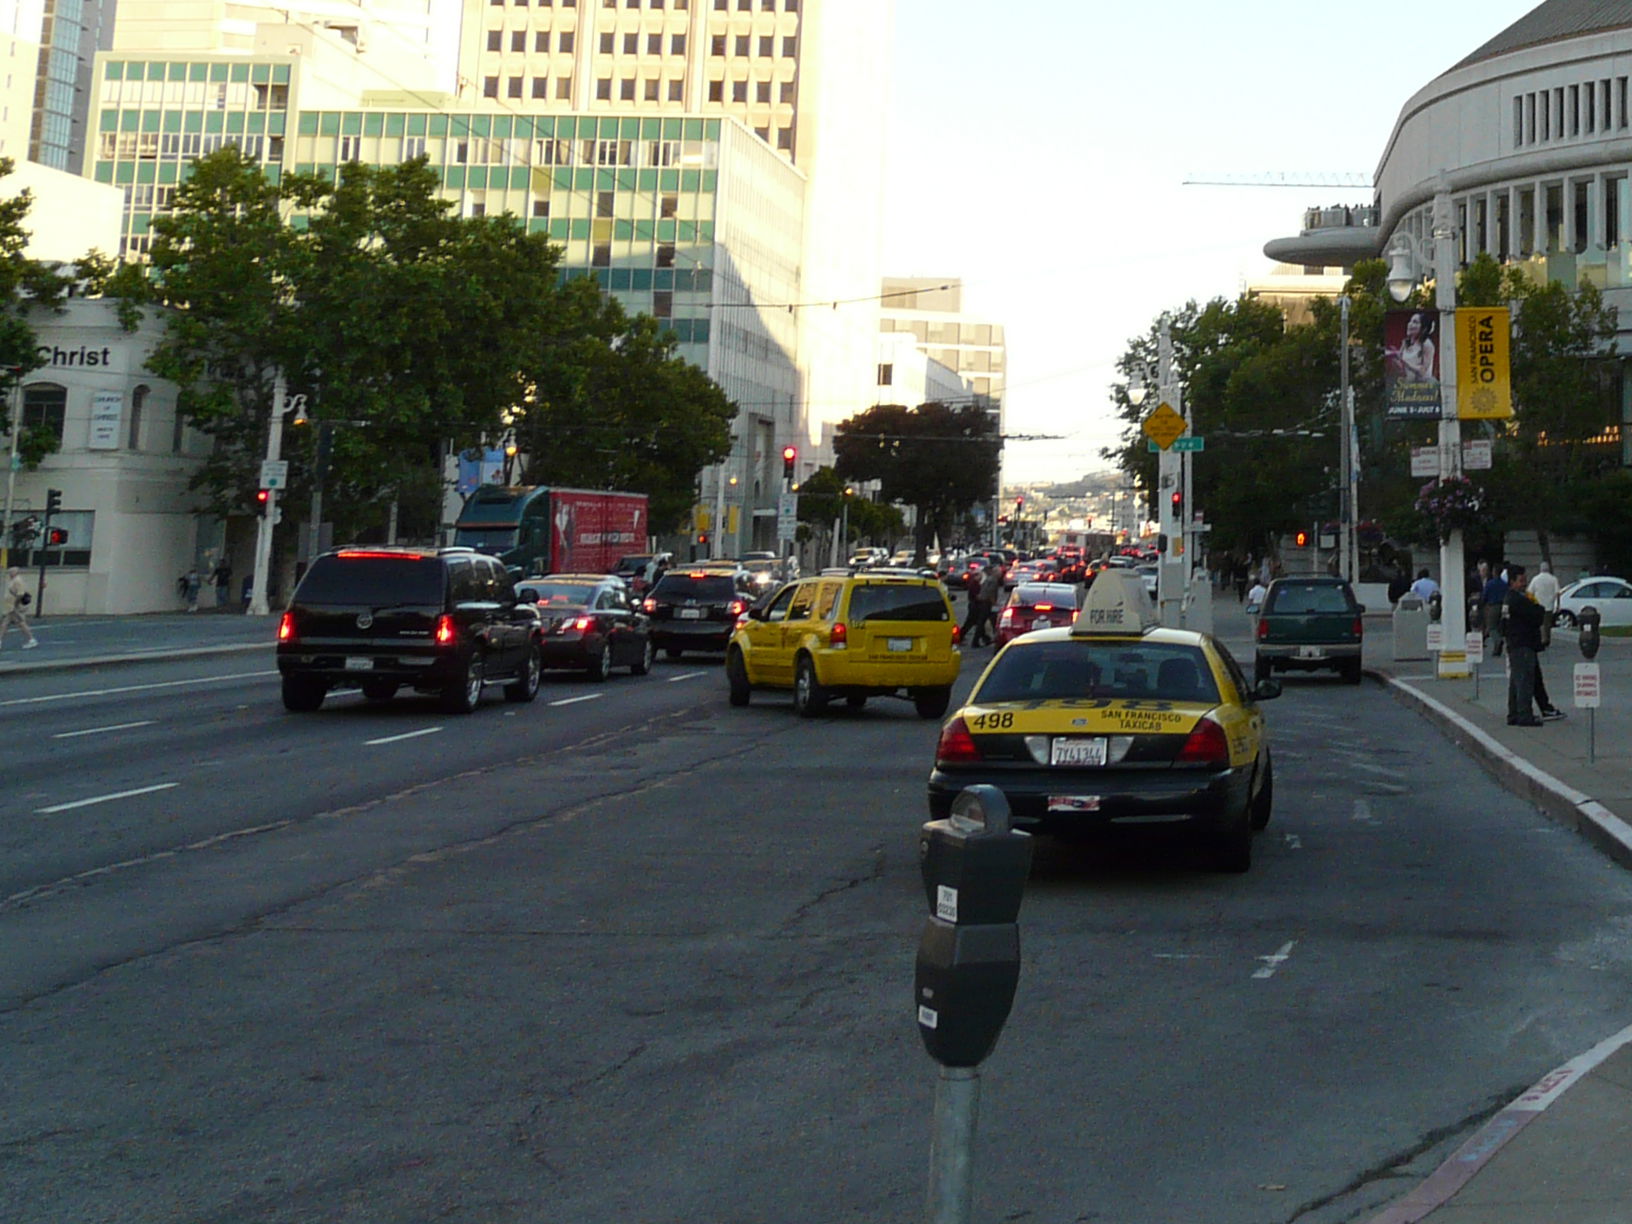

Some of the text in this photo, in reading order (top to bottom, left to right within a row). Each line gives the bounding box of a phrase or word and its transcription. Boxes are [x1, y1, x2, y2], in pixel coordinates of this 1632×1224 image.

[1479, 315, 1495, 383] OPERA
[1090, 609, 1124, 624] FOR HIRE
[973, 710, 1181, 729] 498 SAN FRANCISCO
[1119, 719, 1162, 731] TAXICAB
